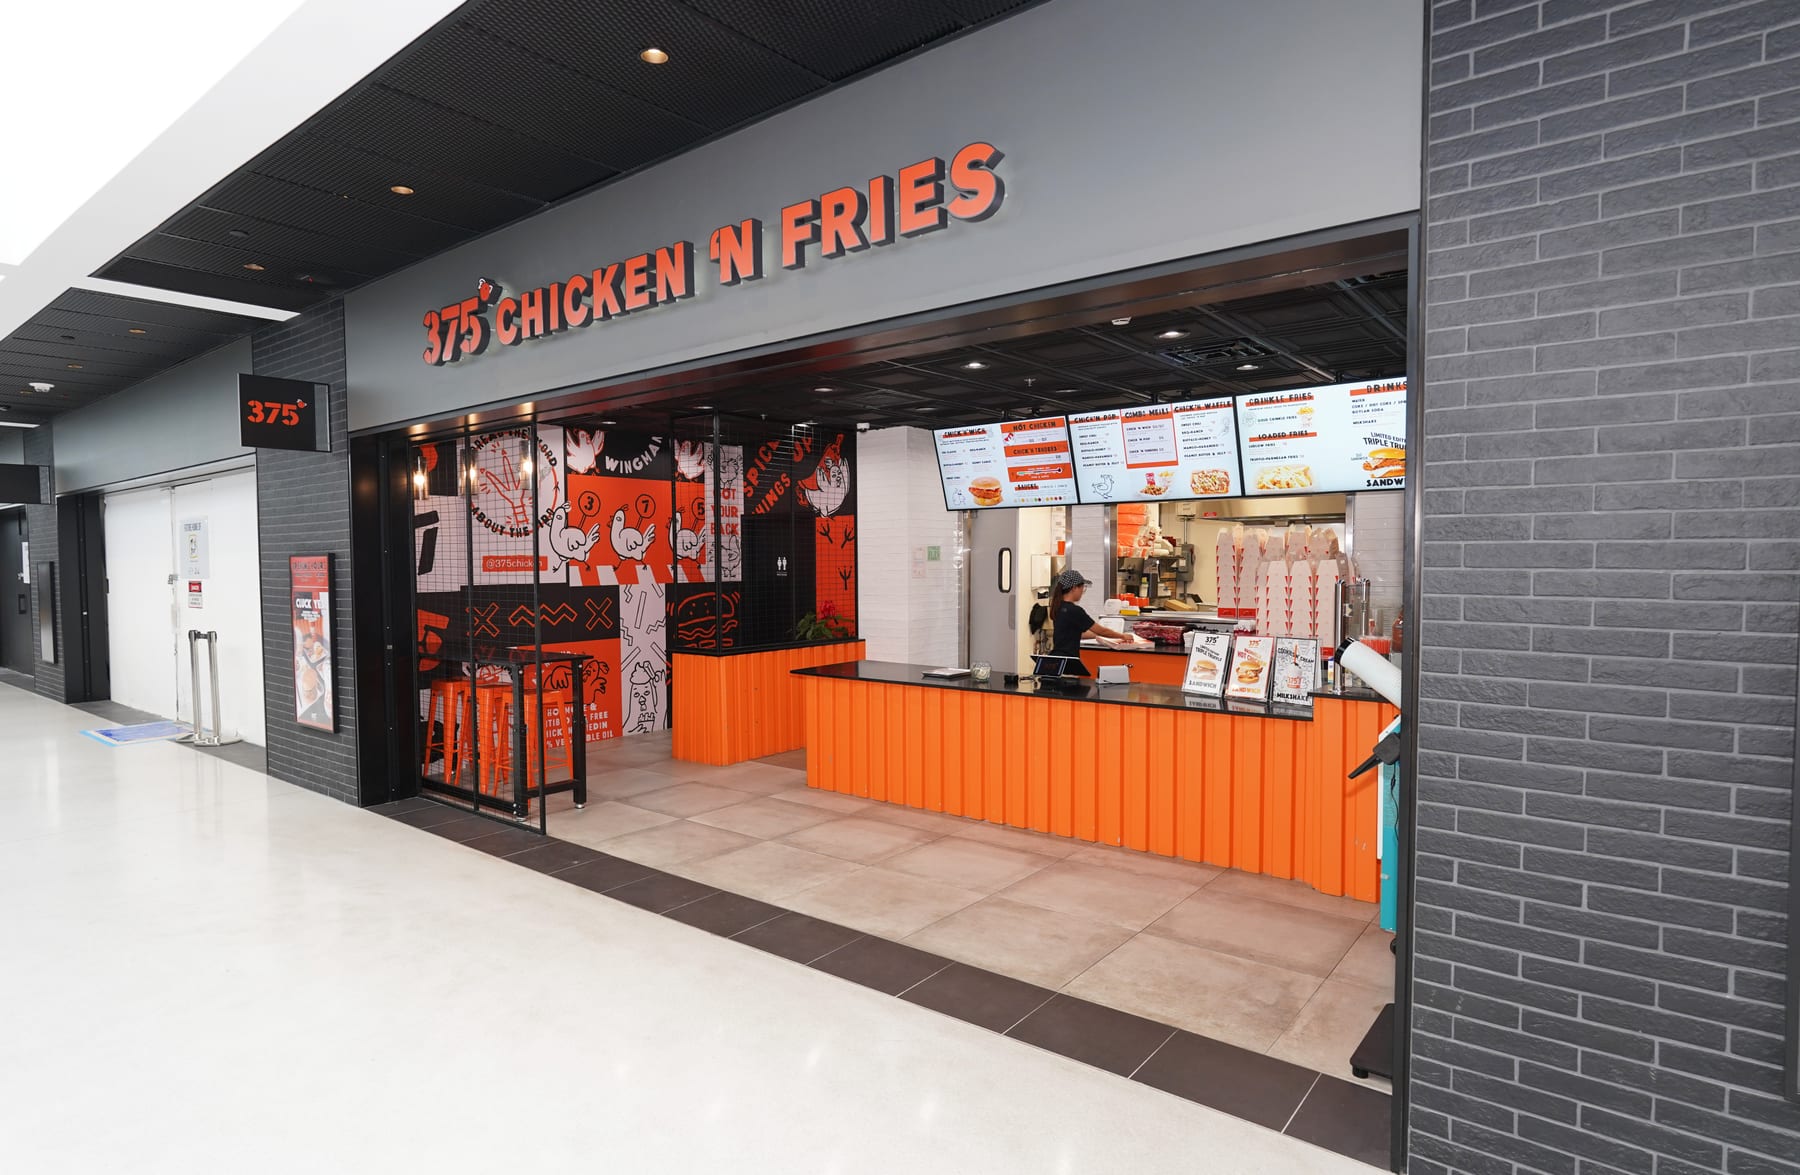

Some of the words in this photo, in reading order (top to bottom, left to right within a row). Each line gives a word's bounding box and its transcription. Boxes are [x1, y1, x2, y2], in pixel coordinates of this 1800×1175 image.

[496, 240, 691, 346] CHICKEN
[781, 142, 1005, 276] FRIES
[1288, 392, 1313, 402] FRIES
[1258, 432, 1287, 440] LOADED
[1363, 437, 1389, 448] TRIPLE
[605, 436, 663, 474] WINGMAN
[1366, 478, 1407, 487] SANDW
[584, 496, 594, 512] 3
[641, 499, 650, 513] 7
[697, 501, 706, 516] 5
[472, 506, 506, 536] ABOUT
[509, 526, 530, 538] THE
[487, 557, 543, 571] @375chickn
[590, 711, 608, 721] FREE
